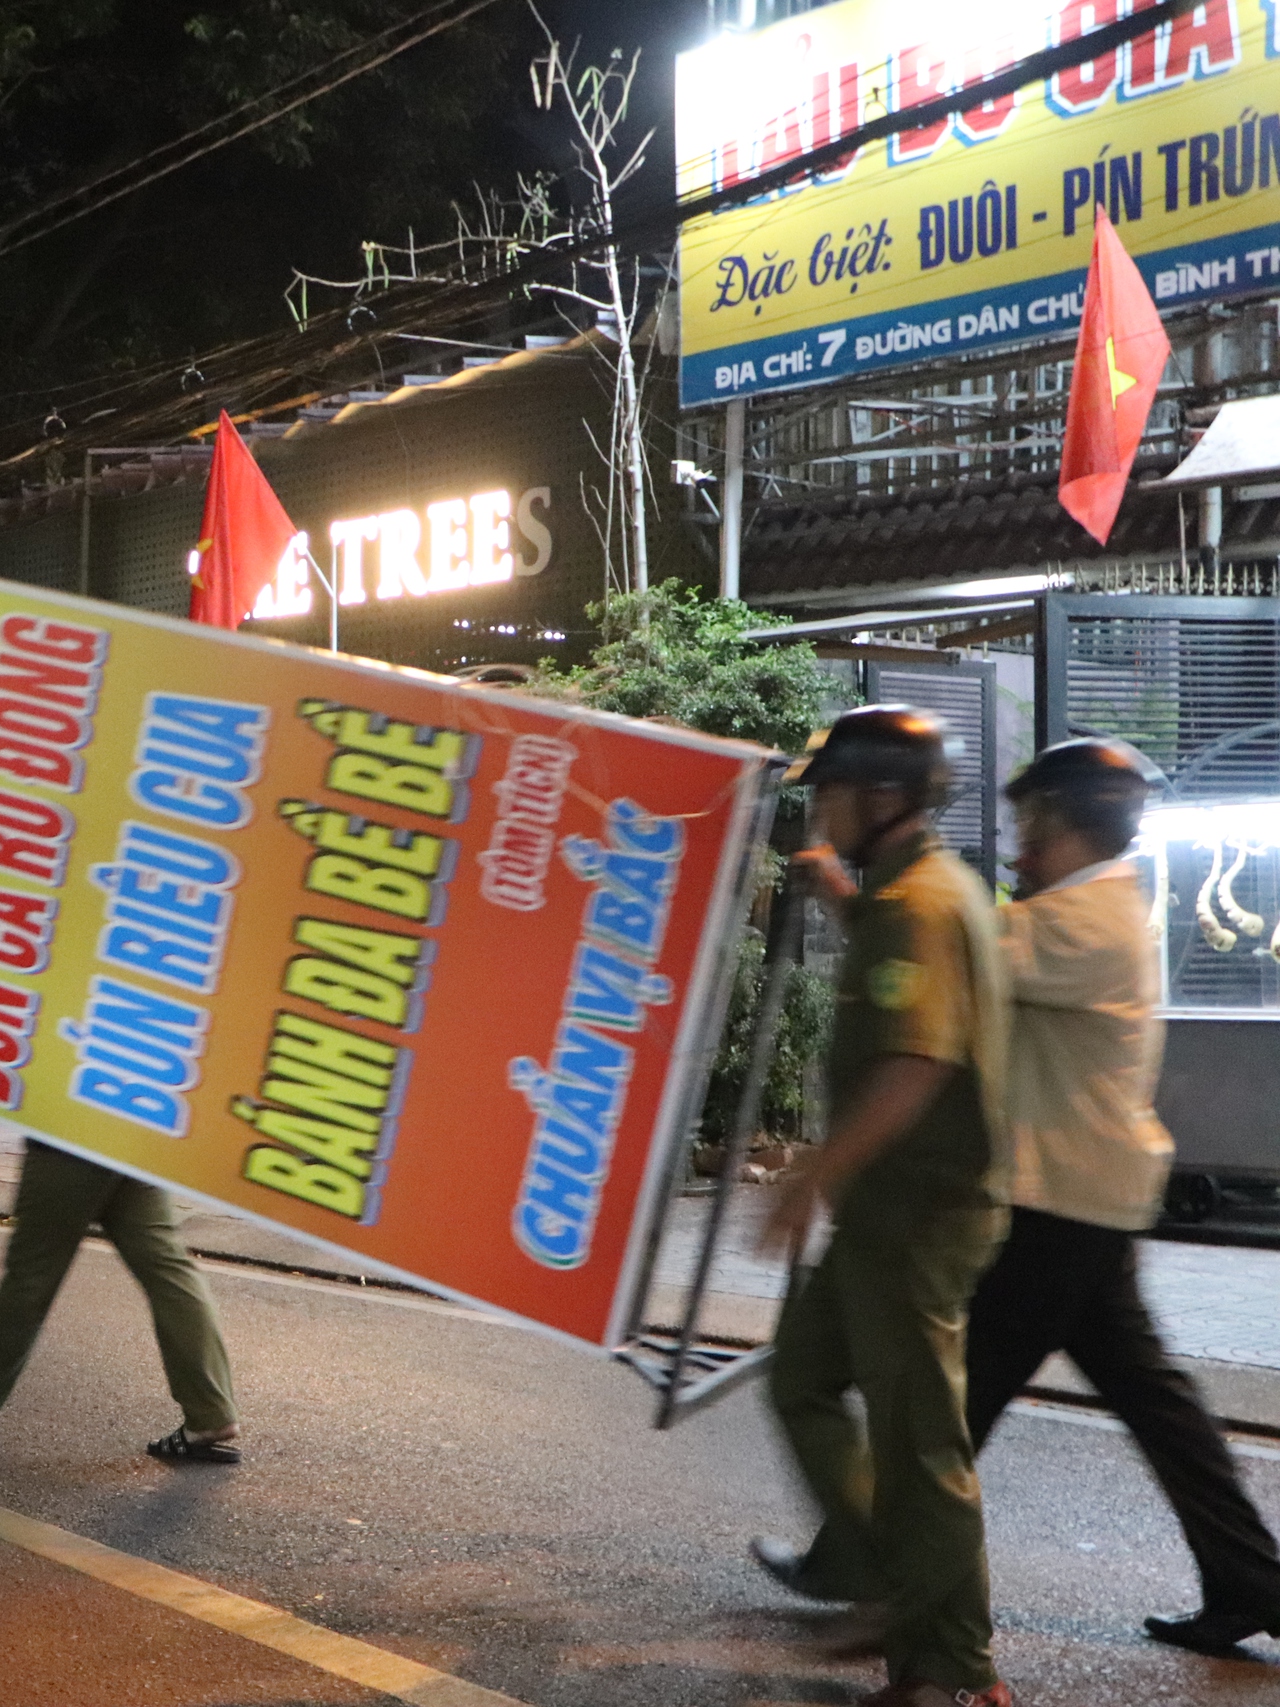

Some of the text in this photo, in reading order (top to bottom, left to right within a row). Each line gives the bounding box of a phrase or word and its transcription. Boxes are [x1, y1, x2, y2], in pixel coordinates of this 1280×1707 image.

[710, 250, 798, 317] Đặc
[917, 180, 1017, 270] ĐUÔI
[1063, 143, 1142, 237] PÍN
[715, 361, 757, 391] ĐỊA
[762, 341, 813, 378] CHỈ:
[817, 328, 847, 367] 7
[855, 319, 951, 361] ĐƯỜNG
[958, 303, 1020, 341] DÂN
[1155, 256, 1236, 299] BÌNH
[329, 485, 553, 606] TREES
[130, 691, 270, 830] CUA
[90, 820, 240, 995] RIÊU
[231, 697, 477, 1223] BÁNH ĐA BỀ BỀ
[59, 974, 210, 1138] BÚN
[508, 797, 687, 1271] CHUẨN VỊ BẮC
